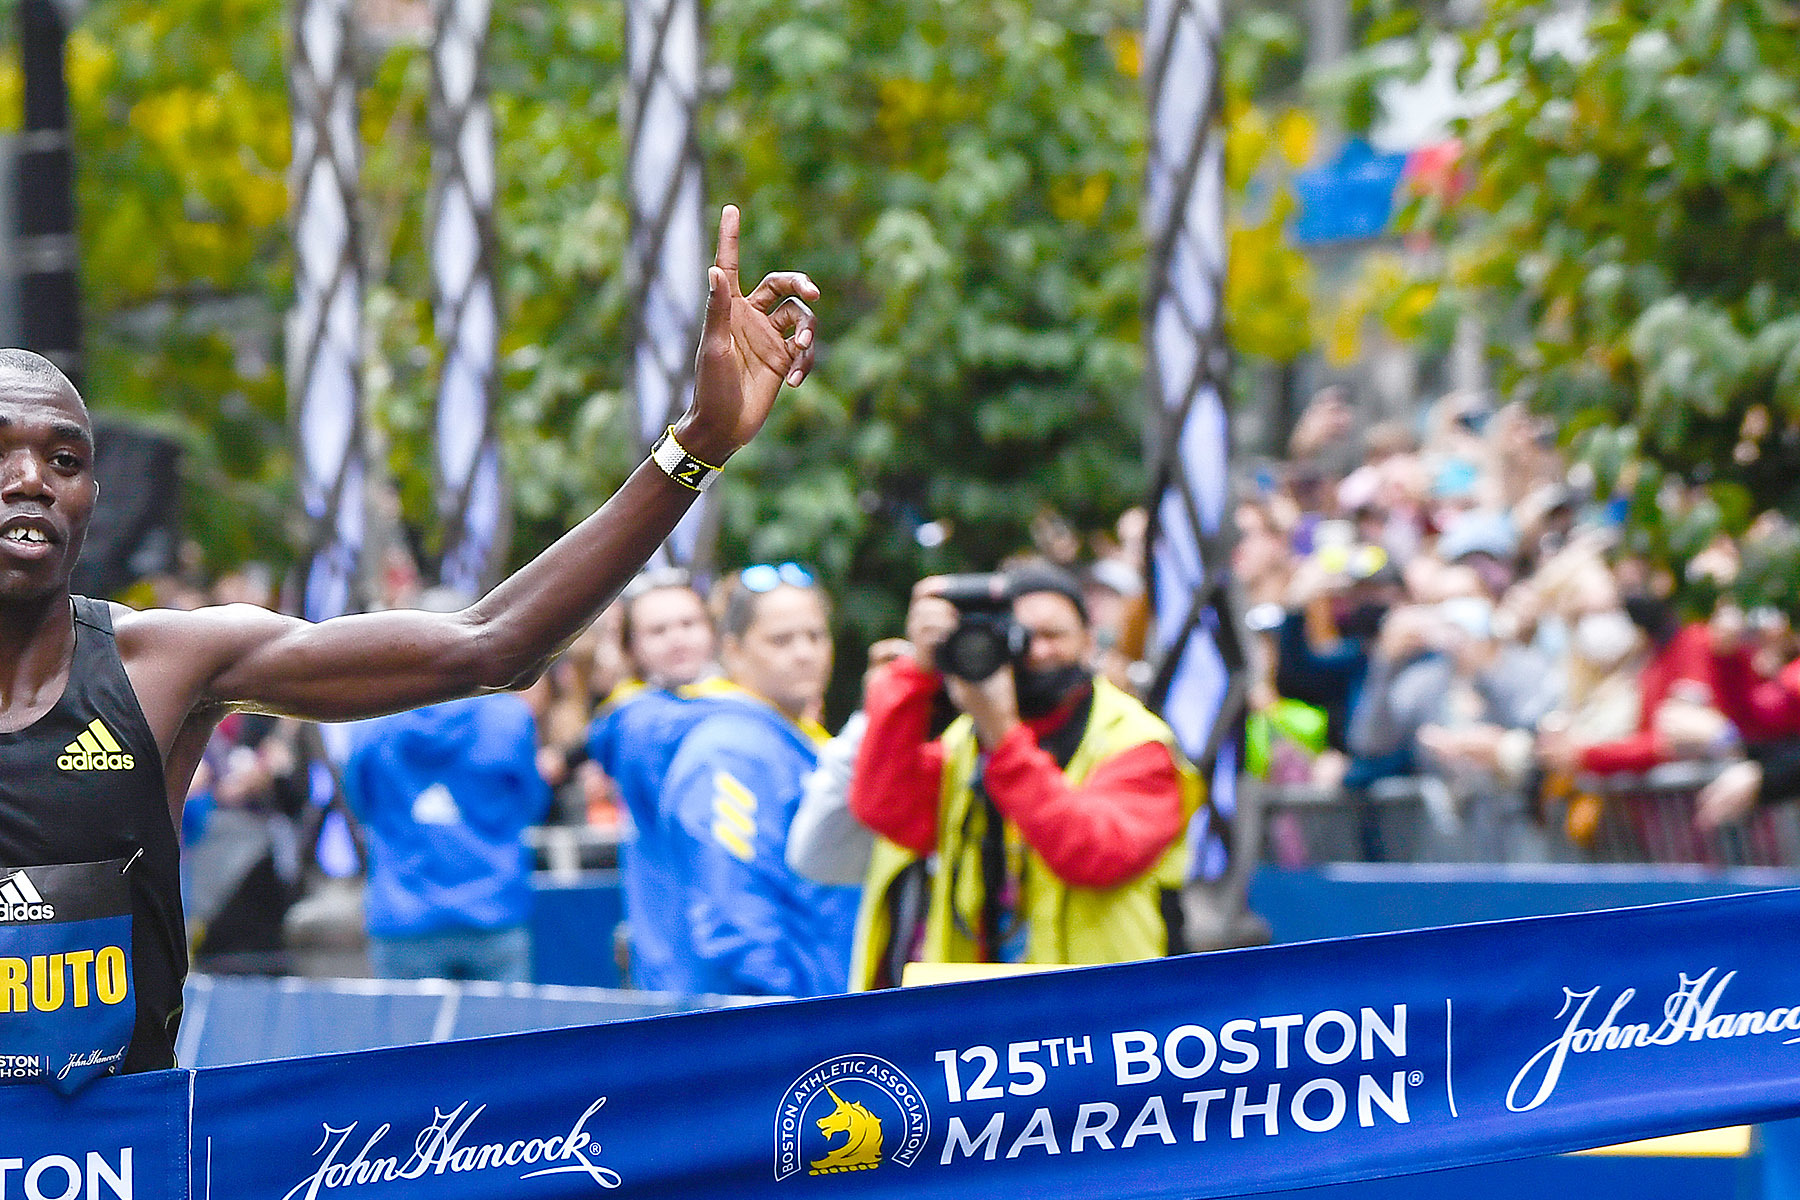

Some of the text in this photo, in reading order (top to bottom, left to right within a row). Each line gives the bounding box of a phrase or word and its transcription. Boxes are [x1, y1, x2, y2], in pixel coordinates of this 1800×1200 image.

[57, 751, 135, 771] adidas
[935, 1003, 1407, 1102] 125TH BOSTON
[1505, 985, 1650, 1112] John
[396, 1097, 622, 1189] Hancock
[782, 1061, 924, 1173] BOSTON ATHLETIC ASSOCIATION
